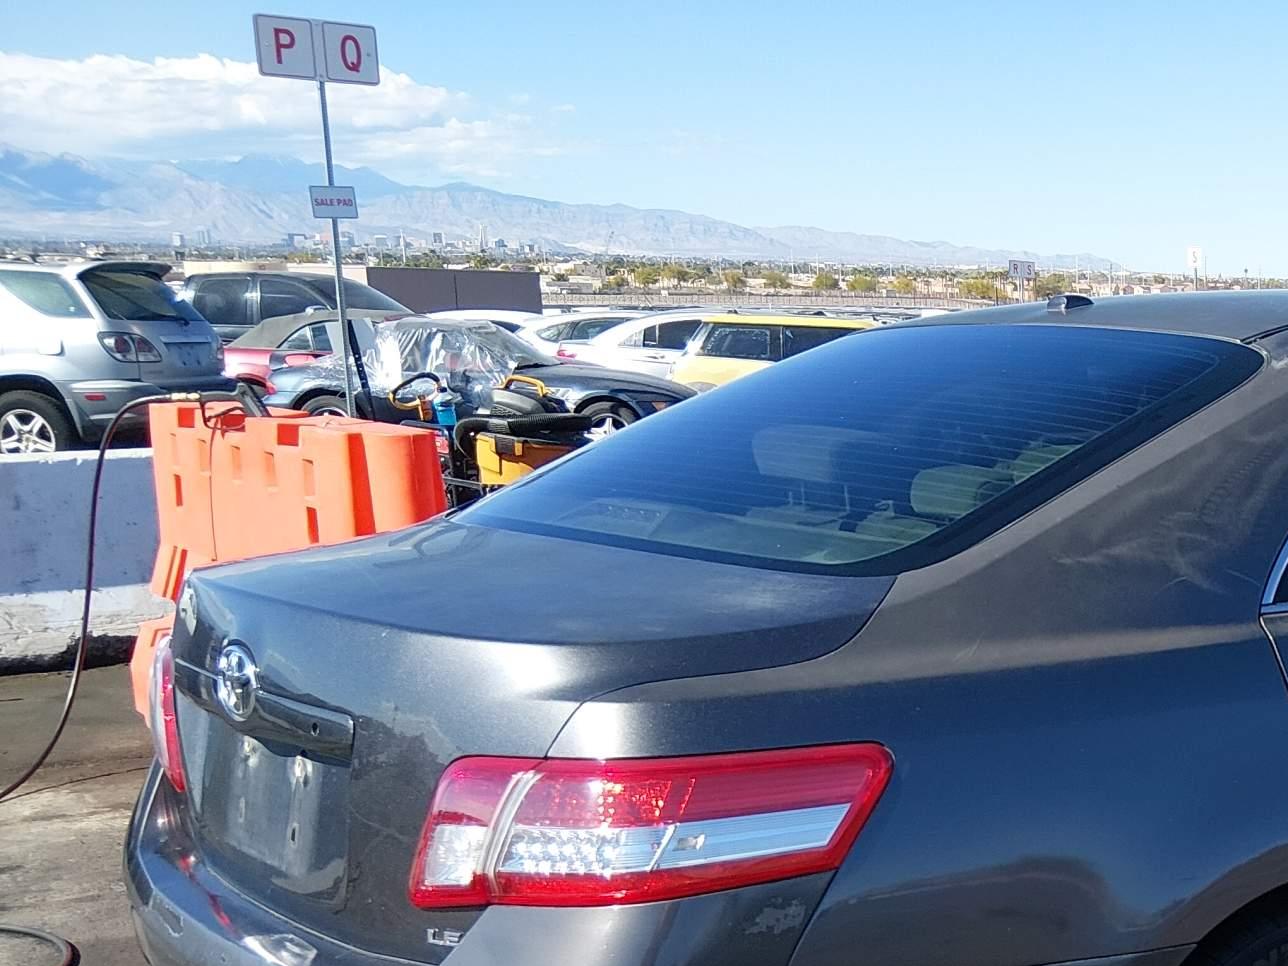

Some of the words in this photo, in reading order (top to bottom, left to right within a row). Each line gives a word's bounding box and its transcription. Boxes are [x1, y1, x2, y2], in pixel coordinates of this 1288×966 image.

[273, 27, 296, 65] P
[340, 34, 362, 73] Q
[314, 198, 335, 207] SALE
[336, 198, 354, 207] PAD
[427, 928, 463, 946] LE
